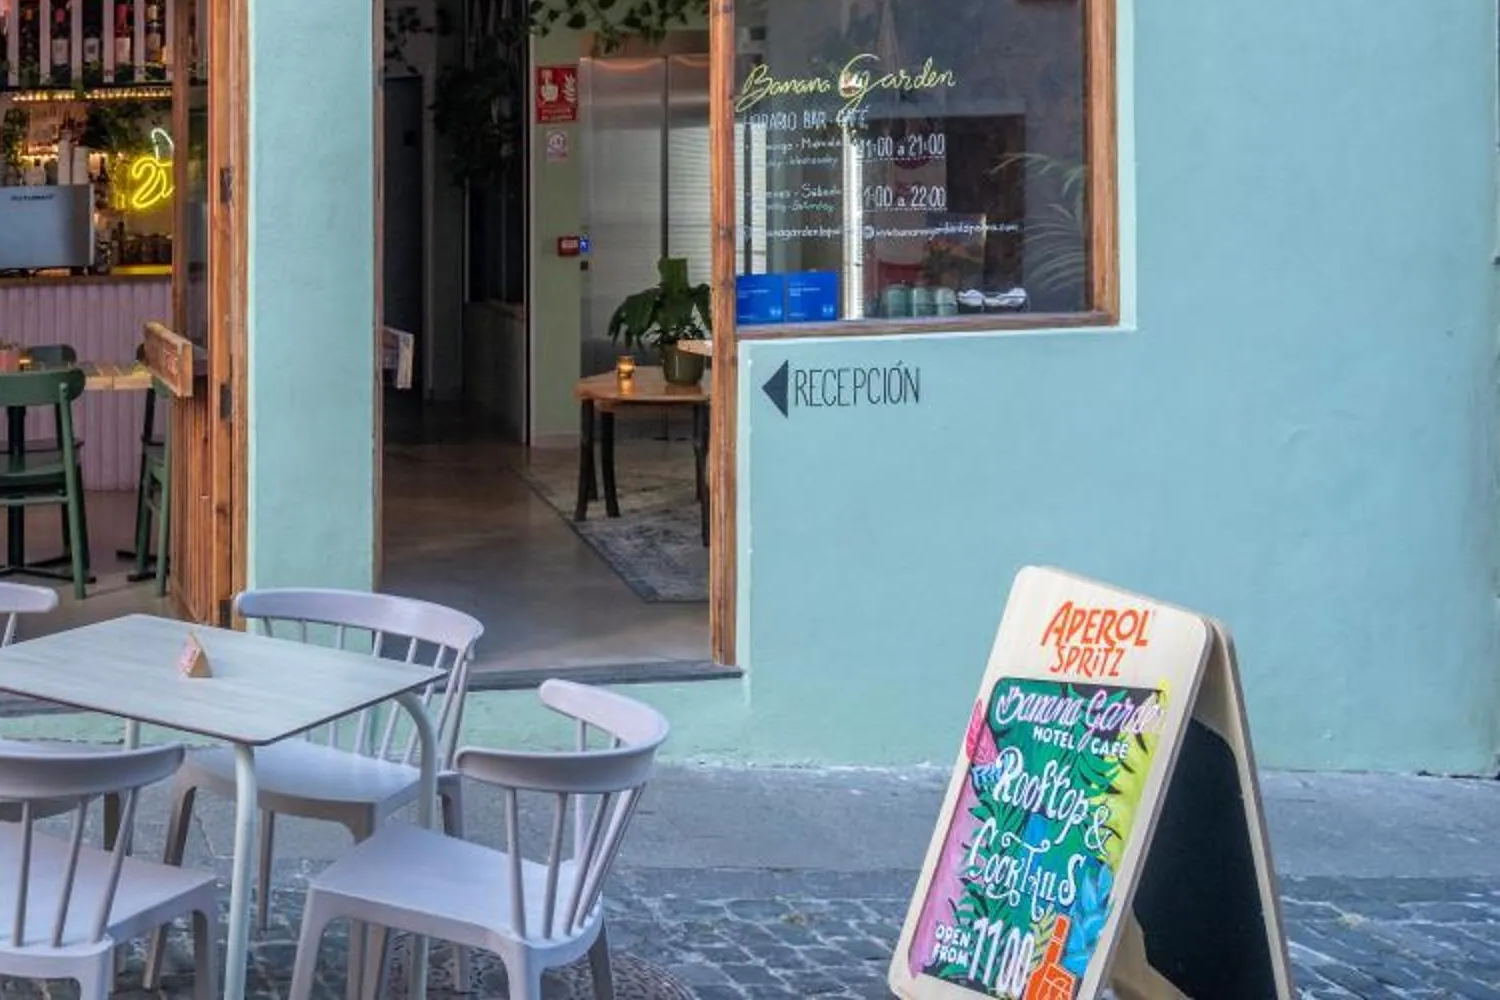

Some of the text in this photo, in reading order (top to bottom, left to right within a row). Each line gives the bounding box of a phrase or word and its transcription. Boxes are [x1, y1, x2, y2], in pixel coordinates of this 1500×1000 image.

[735, 52, 956, 116] Banana Garden
[803, 109, 827, 130] BAR
[794, 360, 921, 408] RECEPCIÓN
[1039, 600, 1150, 649] APEROL
[1032, 725, 1075, 750] HOTEL
[993, 745, 1114, 856] Rooftop &
[934, 923, 971, 949] OPEN
[930, 942, 969, 968] FROM
